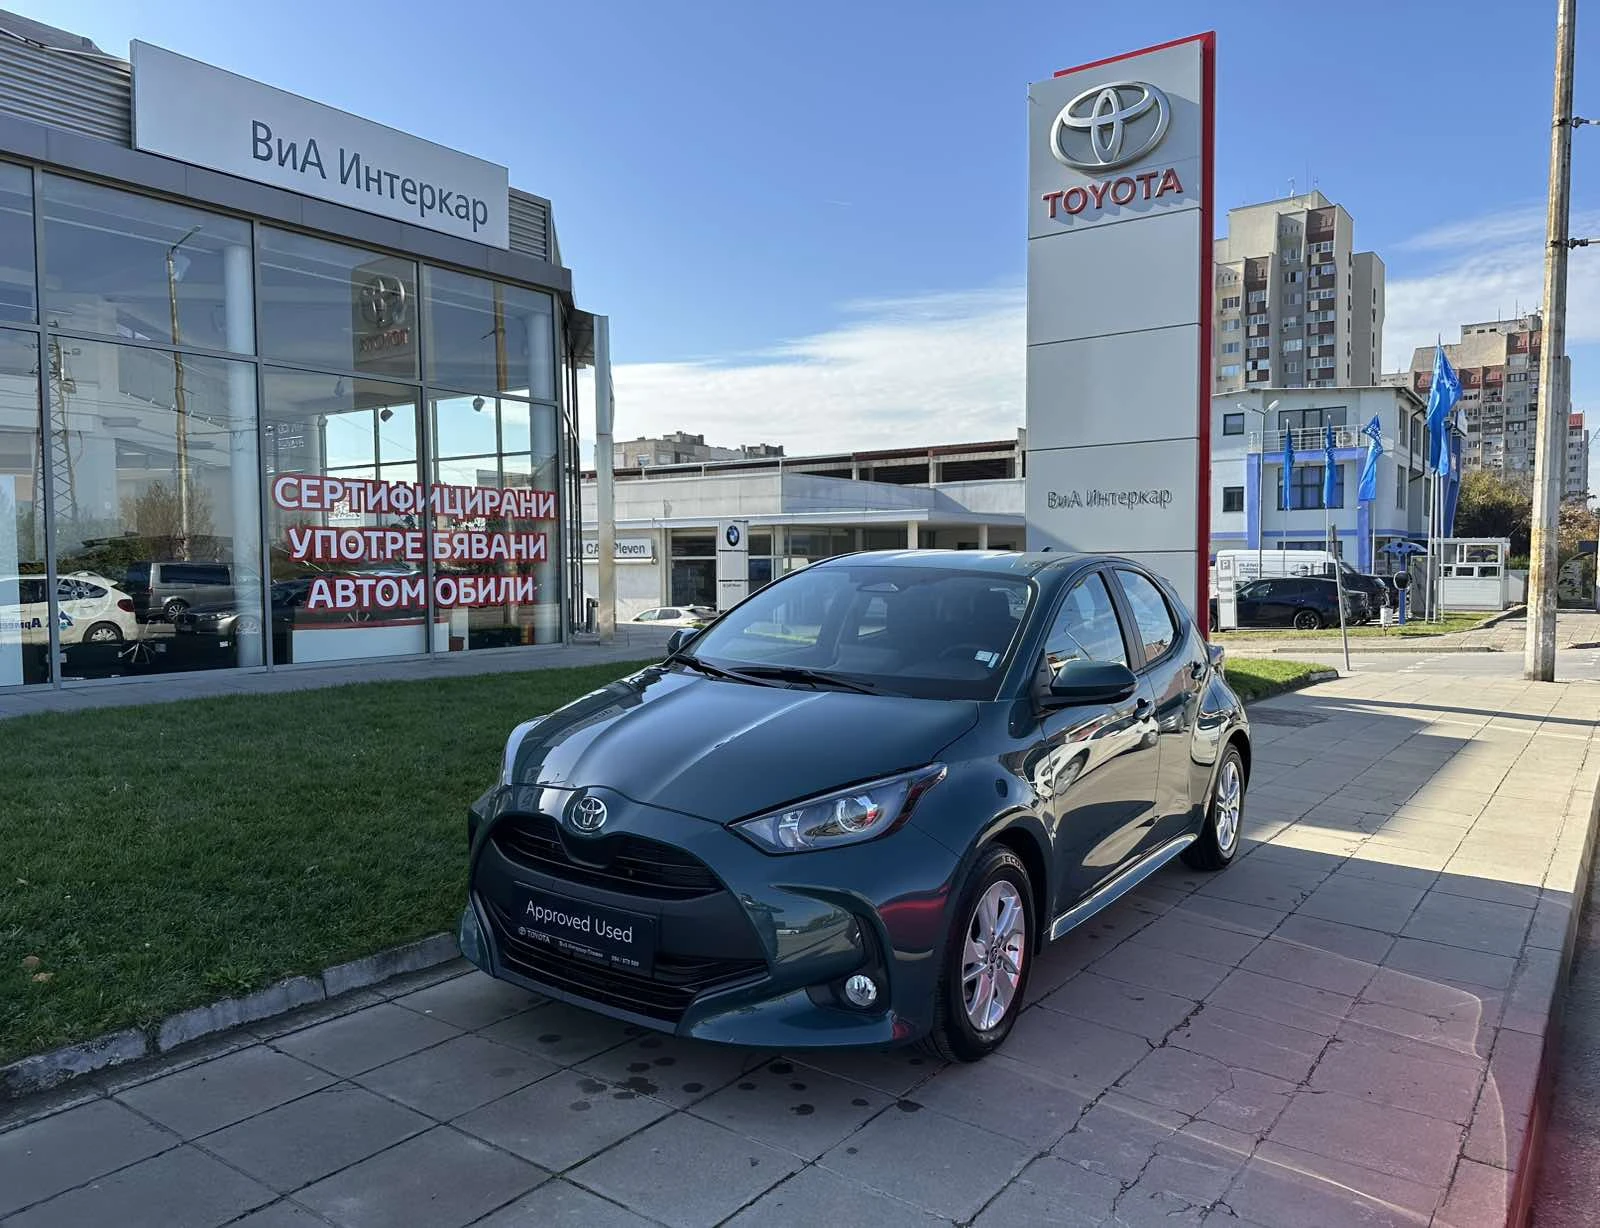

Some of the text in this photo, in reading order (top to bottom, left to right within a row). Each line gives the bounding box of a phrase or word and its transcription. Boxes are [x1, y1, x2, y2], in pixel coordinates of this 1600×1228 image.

[252, 119, 488, 233] ВиА Интеркар
[1041, 167, 1184, 219] TOYOTA
[273, 476, 556, 519] СЕРТИФИЦИРАНИ
[1047, 488, 1173, 510] ВиА Интеркар
[526, 899, 633, 944] Approved Used
[527, 930, 551, 944] TOYOTA
